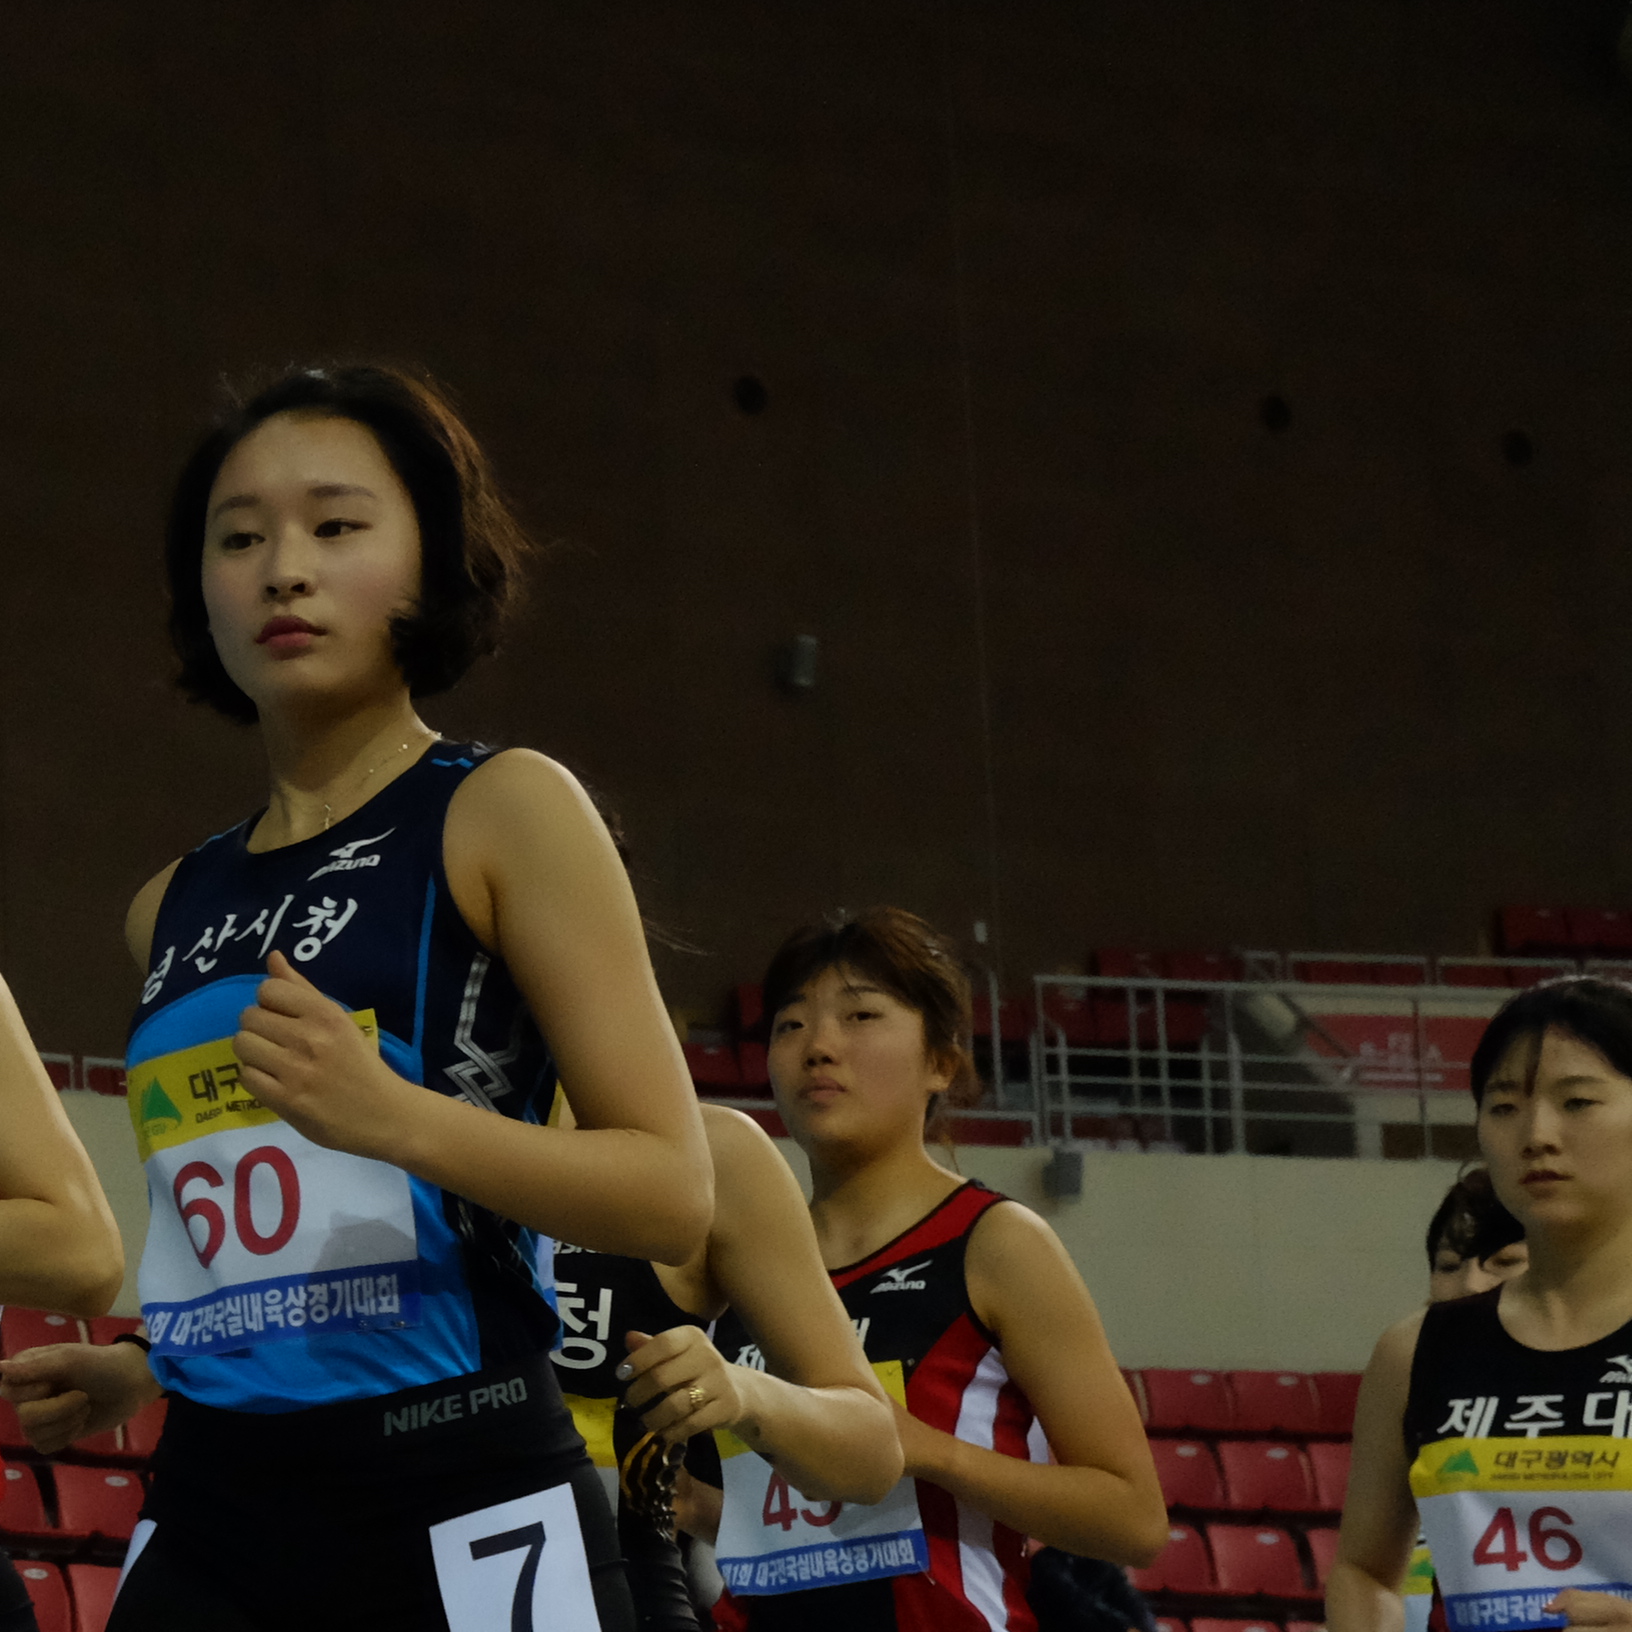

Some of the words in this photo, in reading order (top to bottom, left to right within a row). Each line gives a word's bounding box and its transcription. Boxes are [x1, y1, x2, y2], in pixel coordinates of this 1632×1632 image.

[172, 1144, 302, 1270] 60
[382, 1396, 463, 1437] NIKE
[469, 1376, 528, 1412] PRO
[1472, 1506, 1583, 1572] 46
